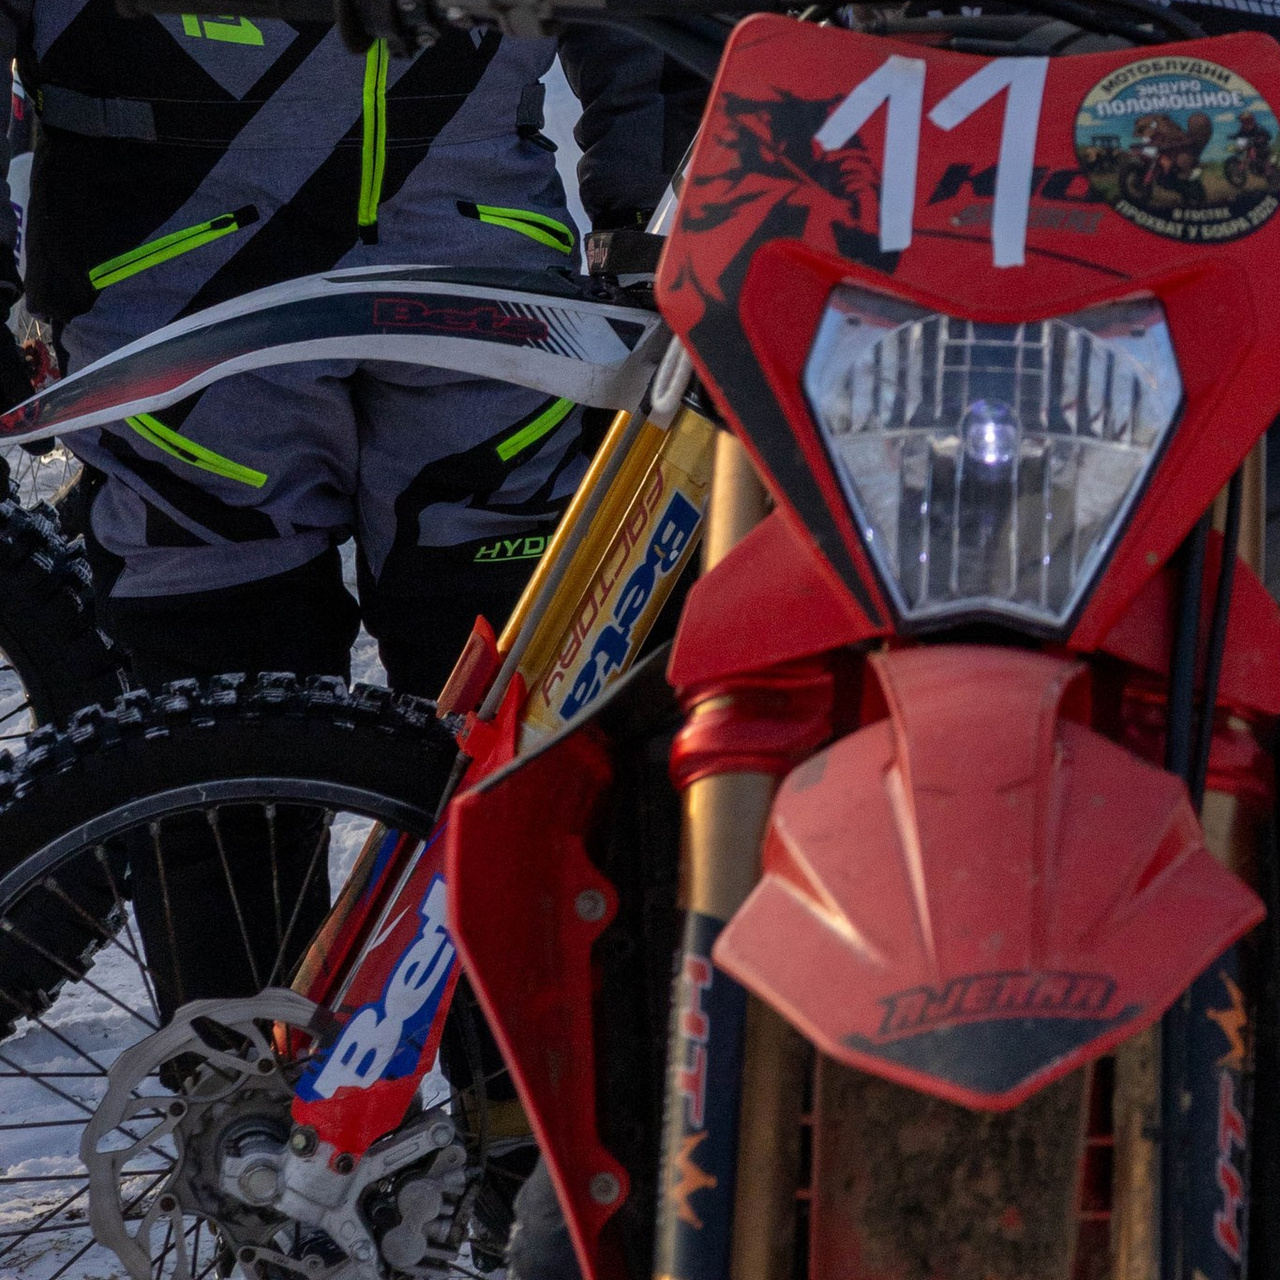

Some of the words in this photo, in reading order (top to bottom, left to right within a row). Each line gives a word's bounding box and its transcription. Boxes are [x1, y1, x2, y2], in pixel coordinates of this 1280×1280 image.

[812, 54, 1050, 269] 11
[372, 297, 549, 341] Beta
[474, 533, 556, 560] HYD
[543, 463, 664, 708] FACTORY
[559, 490, 700, 721] Beta
[311, 878, 456, 1101] Bet
